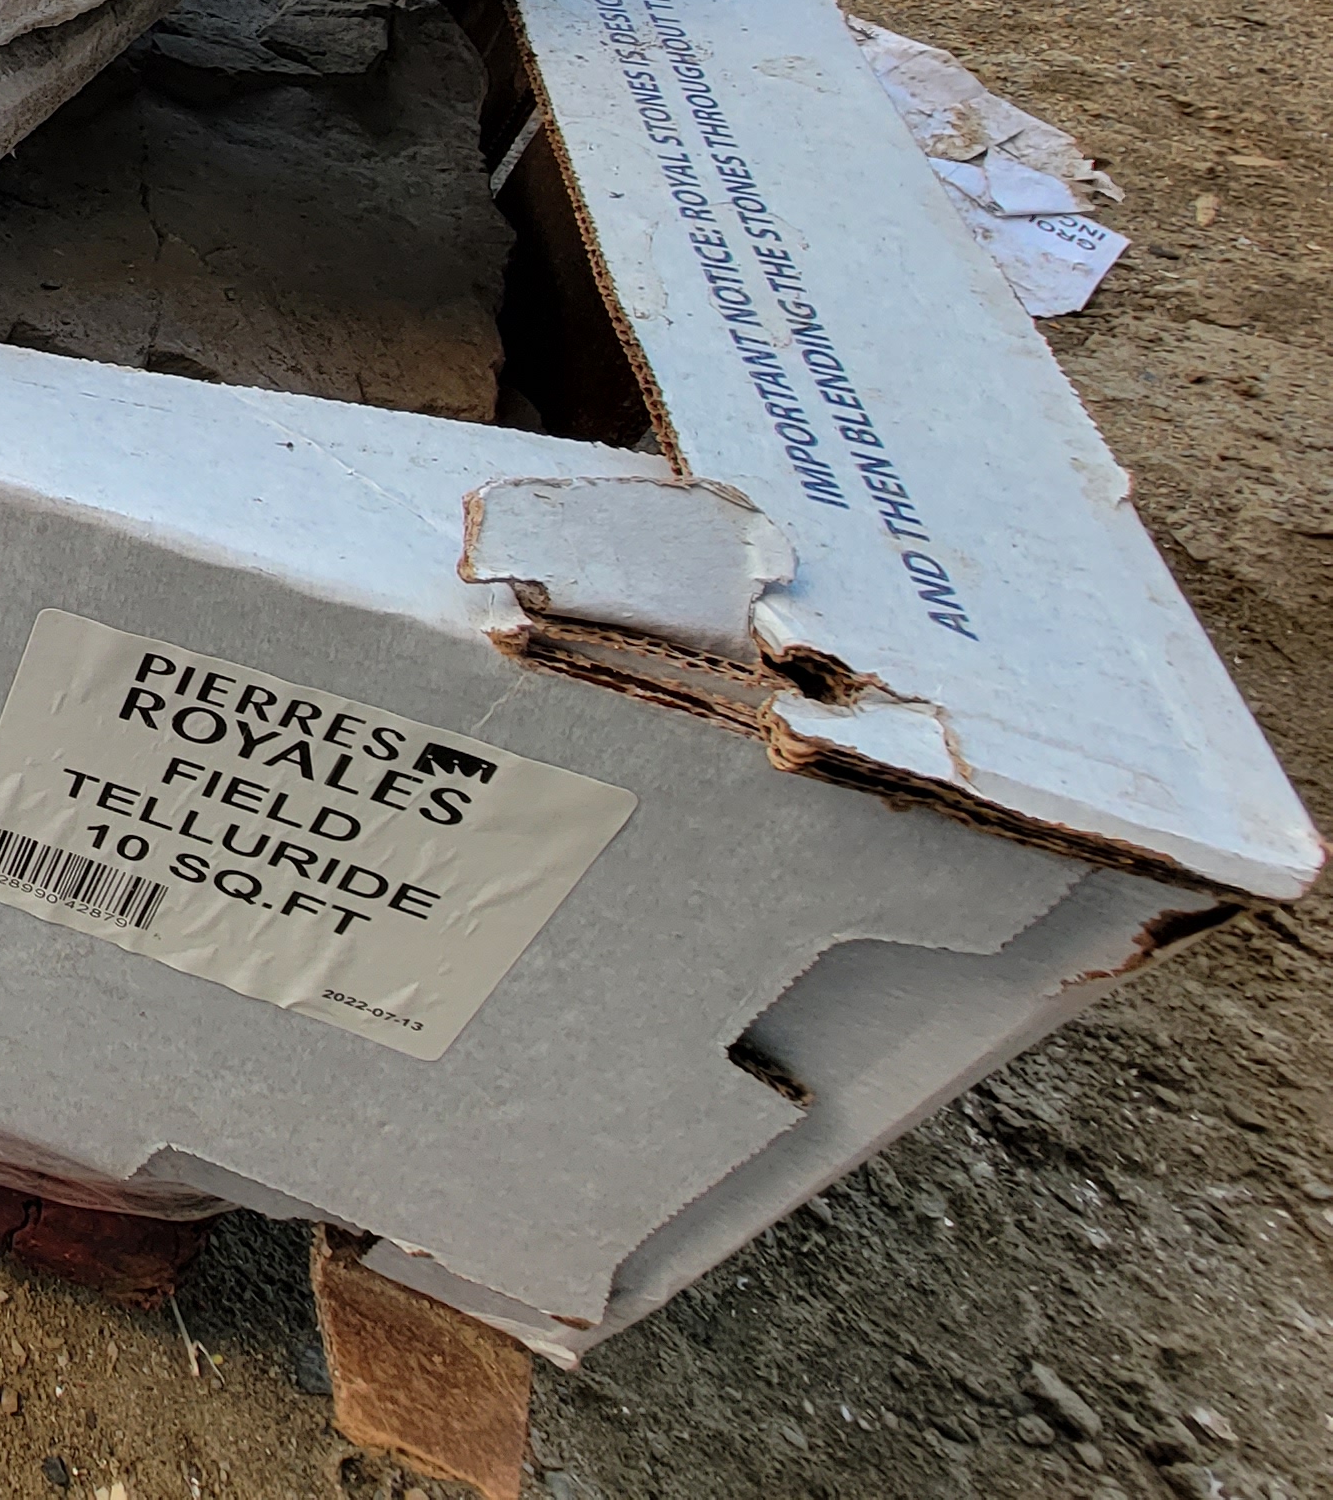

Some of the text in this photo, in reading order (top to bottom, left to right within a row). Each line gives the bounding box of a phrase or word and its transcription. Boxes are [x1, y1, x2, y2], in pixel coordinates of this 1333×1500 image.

[613, 48, 650, 66] IS
[645, 6, 739, 148] THROUGHOUT
[622, 69, 684, 147] STONES
[656, 152, 717, 222] ROYAL
[710, 153, 782, 242] STONES
[688, 226, 763, 327] NOTICE:
[751, 244, 806, 292] THE
[728, 328, 850, 509] IMPORTANT
[776, 298, 884, 448] BLENDING
[849, 451, 930, 542] THEN
[900, 550, 979, 641] AND
[134, 652, 408, 762] PIERRES
[118, 686, 472, 827] ROYALES
[161, 757, 362, 842] FIELD
[62, 768, 442, 921] TELLURIDE
[86, 823, 372, 936] 10 SQ.FT
[64, 900, 129, 929] 42879
[322, 989, 425, 1032] 2022-07-13
